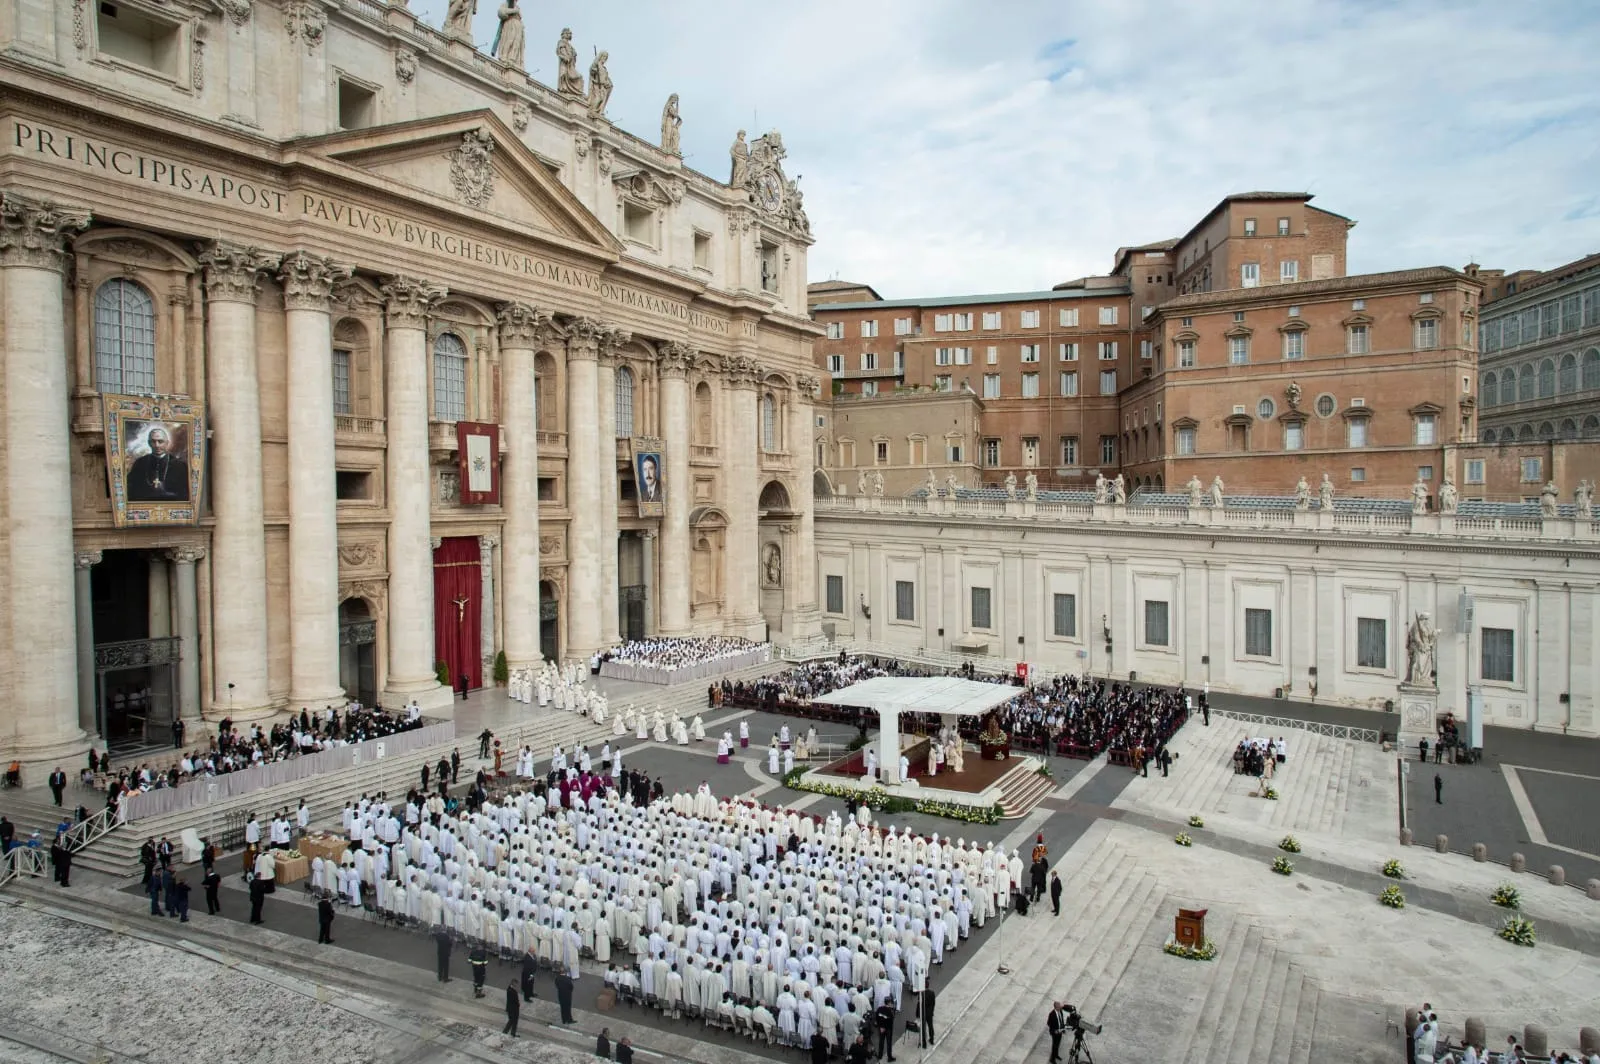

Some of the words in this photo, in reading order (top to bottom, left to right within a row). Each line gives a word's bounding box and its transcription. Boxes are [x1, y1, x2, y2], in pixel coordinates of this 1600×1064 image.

[15, 121, 193, 190] PRINCIPIS
[303, 194, 381, 234] PAVLVS
[386, 218, 398, 237] V
[404, 223, 519, 271] BVRGHESIVS
[523, 256, 600, 292] ROMANVS
